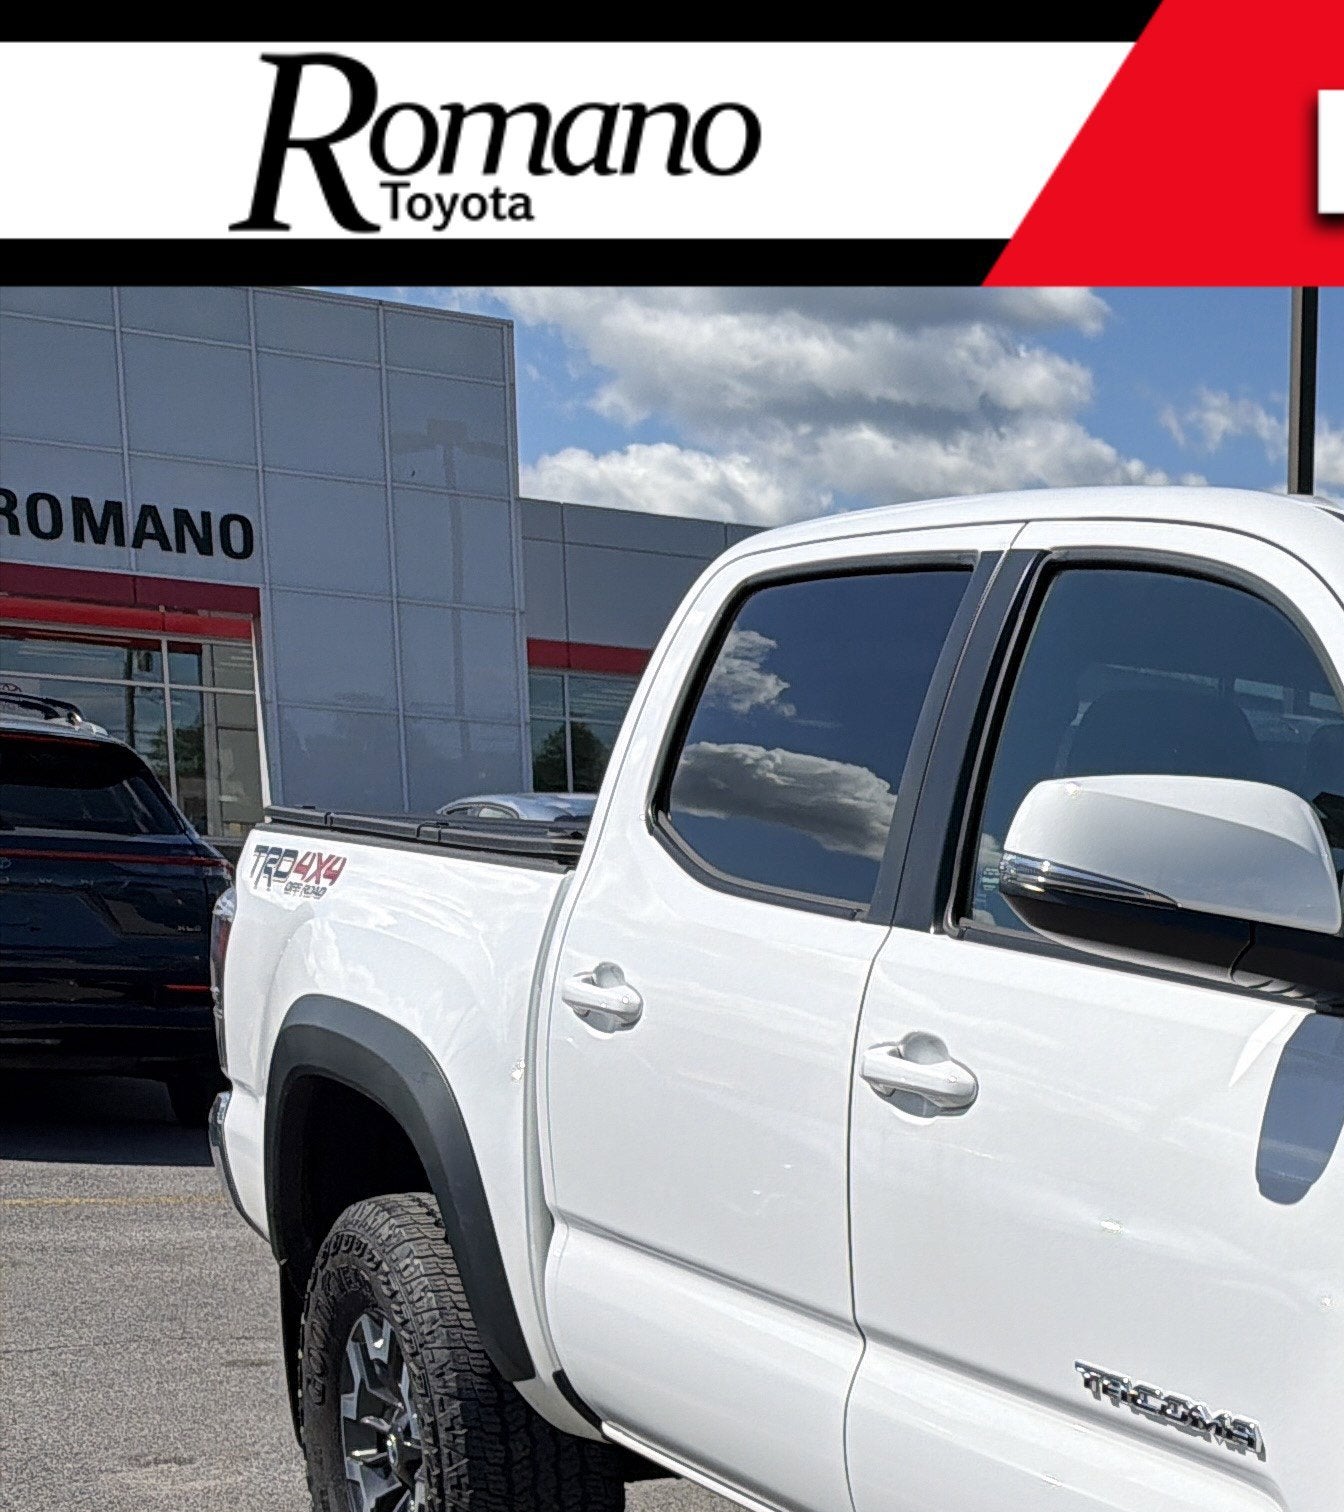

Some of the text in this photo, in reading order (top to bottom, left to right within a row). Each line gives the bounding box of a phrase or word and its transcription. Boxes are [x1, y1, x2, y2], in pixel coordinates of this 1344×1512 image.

[0, 487, 254, 560] ROMANO
[250, 844, 299, 892] TRD
[1074, 1360, 1267, 1462] TACOMA
